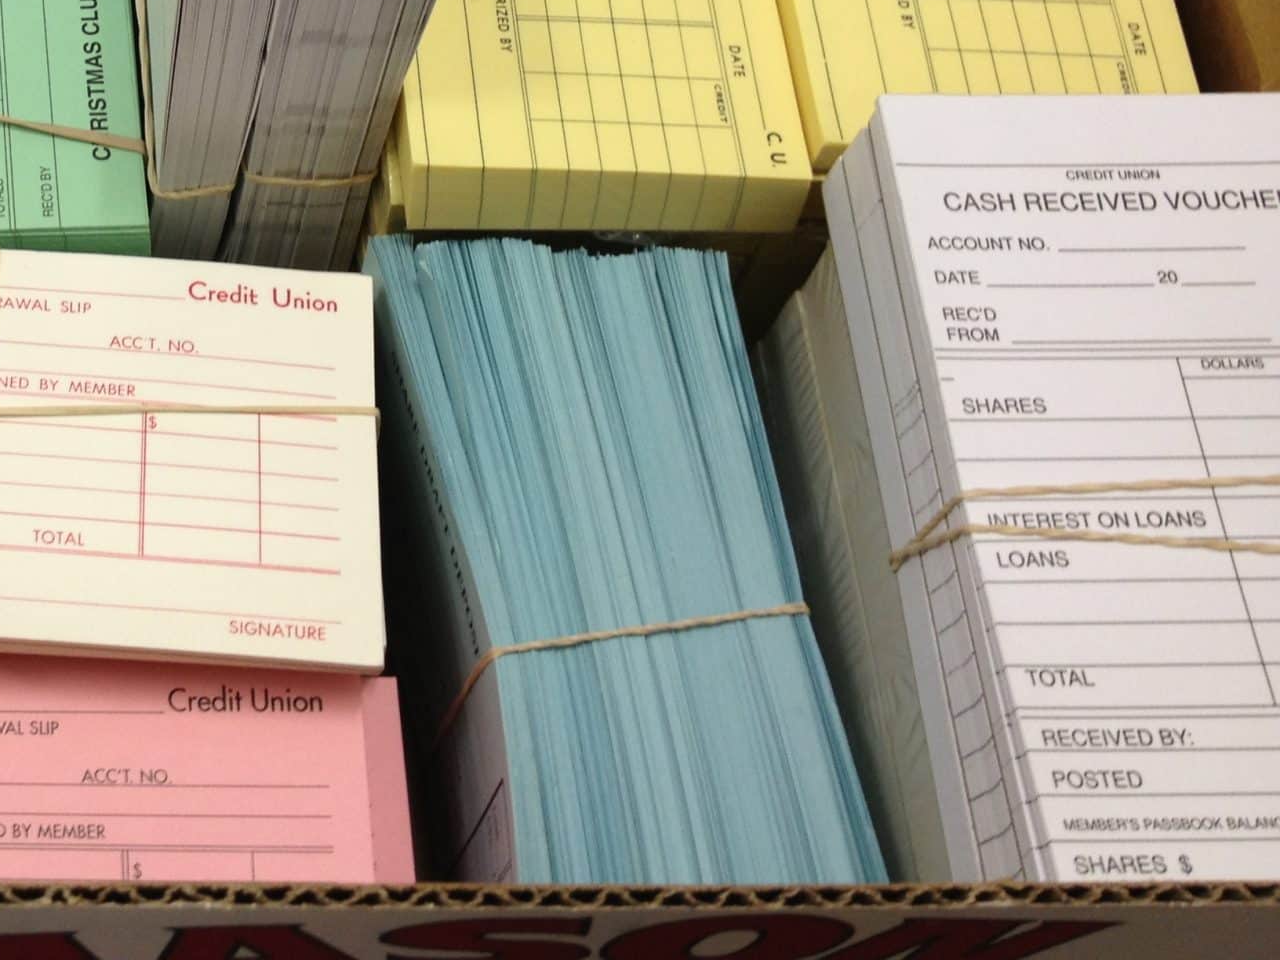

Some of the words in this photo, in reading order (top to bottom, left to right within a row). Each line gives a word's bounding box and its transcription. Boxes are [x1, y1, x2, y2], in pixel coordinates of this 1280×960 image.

[902, 14, 916, 30] BY
[499, 38, 513, 53] BY
[1127, 22, 1146, 56] DATE
[728, 45, 746, 78] DATE
[84, 41, 112, 161] CRISTMAS
[40, 166, 52, 180] BY
[1066, 169, 1114, 182] CREDIT
[1117, 168, 1160, 182] UNION
[42, 181, 54, 218] REC'D
[942, 192, 1016, 214] CASH
[1024, 191, 1158, 212] RECEIVED
[1163, 188, 1280, 211] VOUCHE
[928, 236, 1014, 252] ACCOUNT
[1018, 236, 1050, 252] NO.
[934, 270, 980, 285] DATE
[1156, 270, 1178, 284] 20
[188, 280, 258, 306] Credit
[272, 286, 338, 314] Union
[60, 300, 92, 314] SLIP
[942, 306, 996, 322] REC'D
[946, 327, 1000, 342] FROM
[1200, 356, 1264, 370] DOLLARS
[38, 378, 60, 392] BY
[68, 380, 136, 398] MEMBER
[962, 397, 1048, 414] SHARES
[148, 413, 158, 430] $
[987, 512, 1091, 530] INTEREST
[1097, 512, 1130, 528] ON
[1134, 510, 1207, 528] LOANS
[32, 529, 84, 546] TOTAL
[996, 550, 1070, 569] LOANS
[228, 620, 328, 642] SIGNATURE
[1024, 668, 1096, 688] TOTAL
[168, 688, 242, 714] Credit
[250, 690, 323, 714] Union
[30, 720, 59, 737] SLIP
[1041, 728, 1154, 748] RECEIVED
[1158, 728, 1195, 748] BY:
[1052, 770, 1144, 790] POSTED
[10, 822, 33, 839] BY
[36, 823, 106, 840] MEMBER
[1063, 818, 1140, 832] MEMBER'S
[1142, 818, 1221, 831] PASSBOOK
[133, 861, 144, 878] $
[1073, 854, 1168, 875] SHARES
[1178, 854, 1193, 875] $
